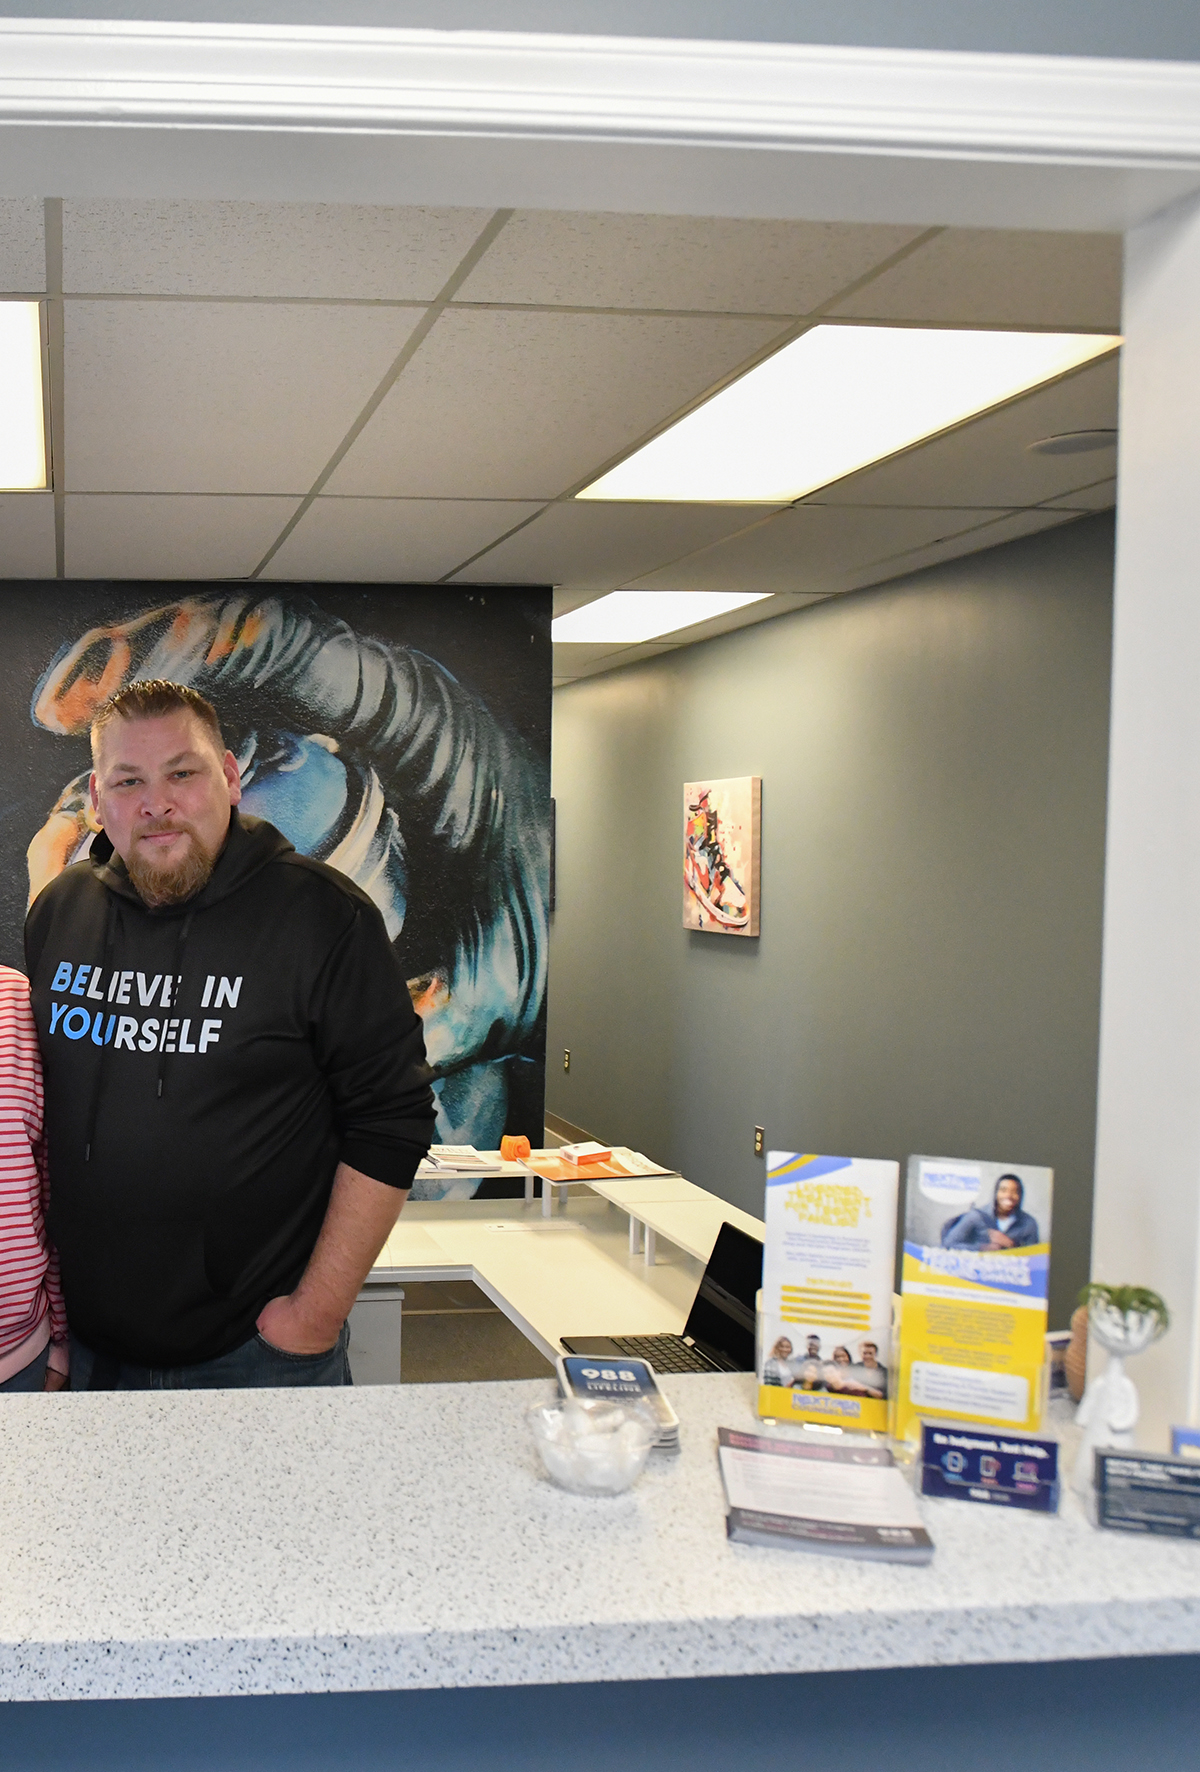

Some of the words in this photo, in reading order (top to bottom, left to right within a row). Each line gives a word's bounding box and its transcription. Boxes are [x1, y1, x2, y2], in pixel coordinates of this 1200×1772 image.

[50, 961, 182, 1008] BELIEVE
[200, 975, 243, 1009] IN
[48, 1002, 223, 1054] YOURSELF
[581, 1368, 637, 1382] 988
